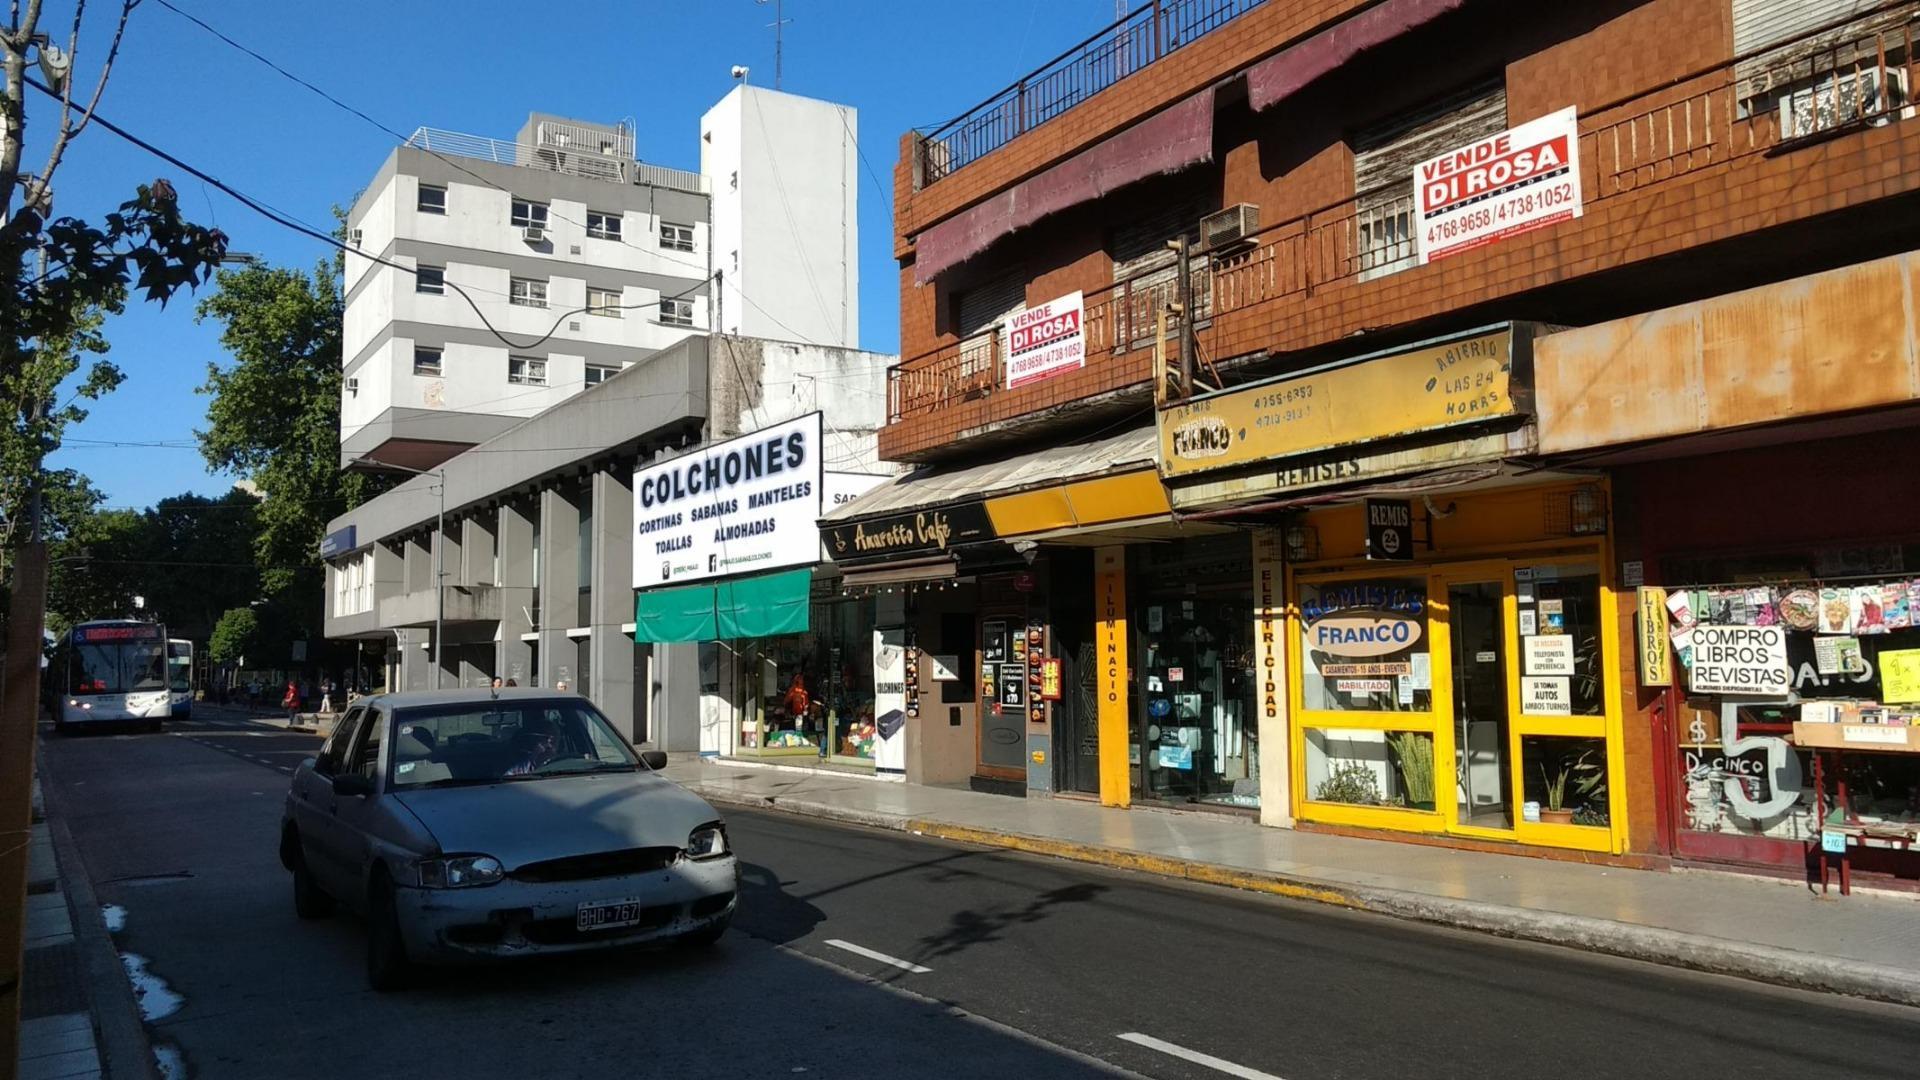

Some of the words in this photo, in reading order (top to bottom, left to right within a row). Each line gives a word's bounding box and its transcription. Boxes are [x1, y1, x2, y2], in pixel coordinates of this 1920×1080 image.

[1422, 134, 1511, 181] VENDE
[1428, 179, 1461, 208] DI
[1466, 144, 1560, 194] ROSA
[1430, 170, 1563, 219] PROPIEDADES
[1013, 305, 1052, 328] VENDE
[1013, 329, 1029, 350] DI
[1031, 314, 1075, 341] ROSA
[1445, 376, 1471, 395] LAS
[1476, 371, 1495, 388] 24
[1446, 391, 1498, 416] HORAS
[1172, 425, 1232, 456] FRANCO
[641, 433, 805, 508] COLCHONES
[1276, 457, 1361, 488] REMISES
[640, 512, 683, 535] CORTINAS
[691, 499, 738, 522] SABANAS
[748, 481, 811, 509] MANTELES
[1370, 505, 1409, 526] REMIS
[656, 535, 692, 555] TOALLAS
[714, 517, 775, 543] ALMOHADAS
[917, 512, 952, 550] Café
[1261, 570, 1276, 718] ELECTRICIDAD
[1317, 621, 1410, 646] FRANCO
[1644, 590, 1658, 681] LIBROS
[1692, 629, 1779, 646] COMPRO
[1695, 647, 1769, 664] LIBROS
[1384, 664, 1407, 673] EVENTOS
[1695, 666, 1787, 685] REVISTAS
[1339, 682, 1390, 690] HABILITADO
[1535, 691, 1558, 701] AUTOS
[1524, 702, 1545, 711] AMBOS
[1547, 702, 1570, 711] TURNOS
[1712, 757, 1764, 774] CINCO
